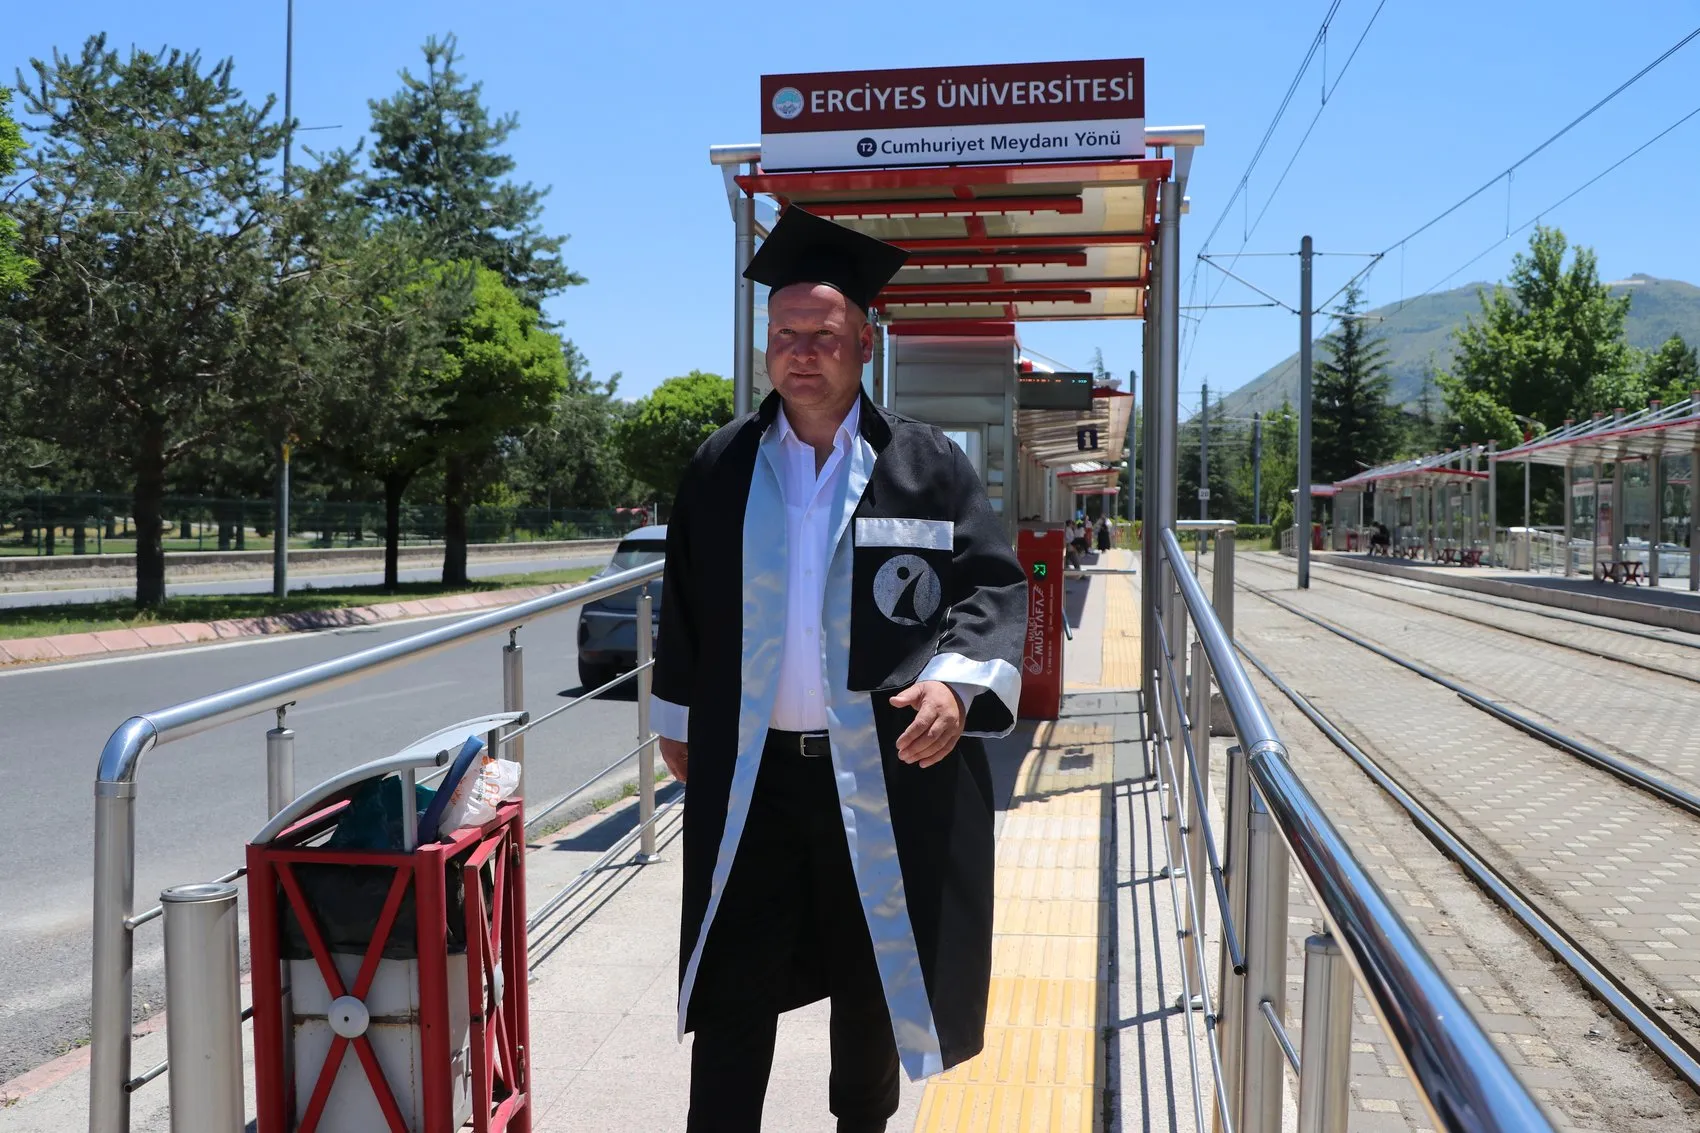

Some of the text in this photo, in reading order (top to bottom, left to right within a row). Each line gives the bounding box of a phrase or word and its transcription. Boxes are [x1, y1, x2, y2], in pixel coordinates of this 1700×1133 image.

[811, 71, 1134, 113] ERCİYES ÜNİVERSİTESİ
[860, 130, 1121, 155] T2 Cumhuriyet Meydanı Yönü
[1034, 599, 1045, 655] MUSTAFA
